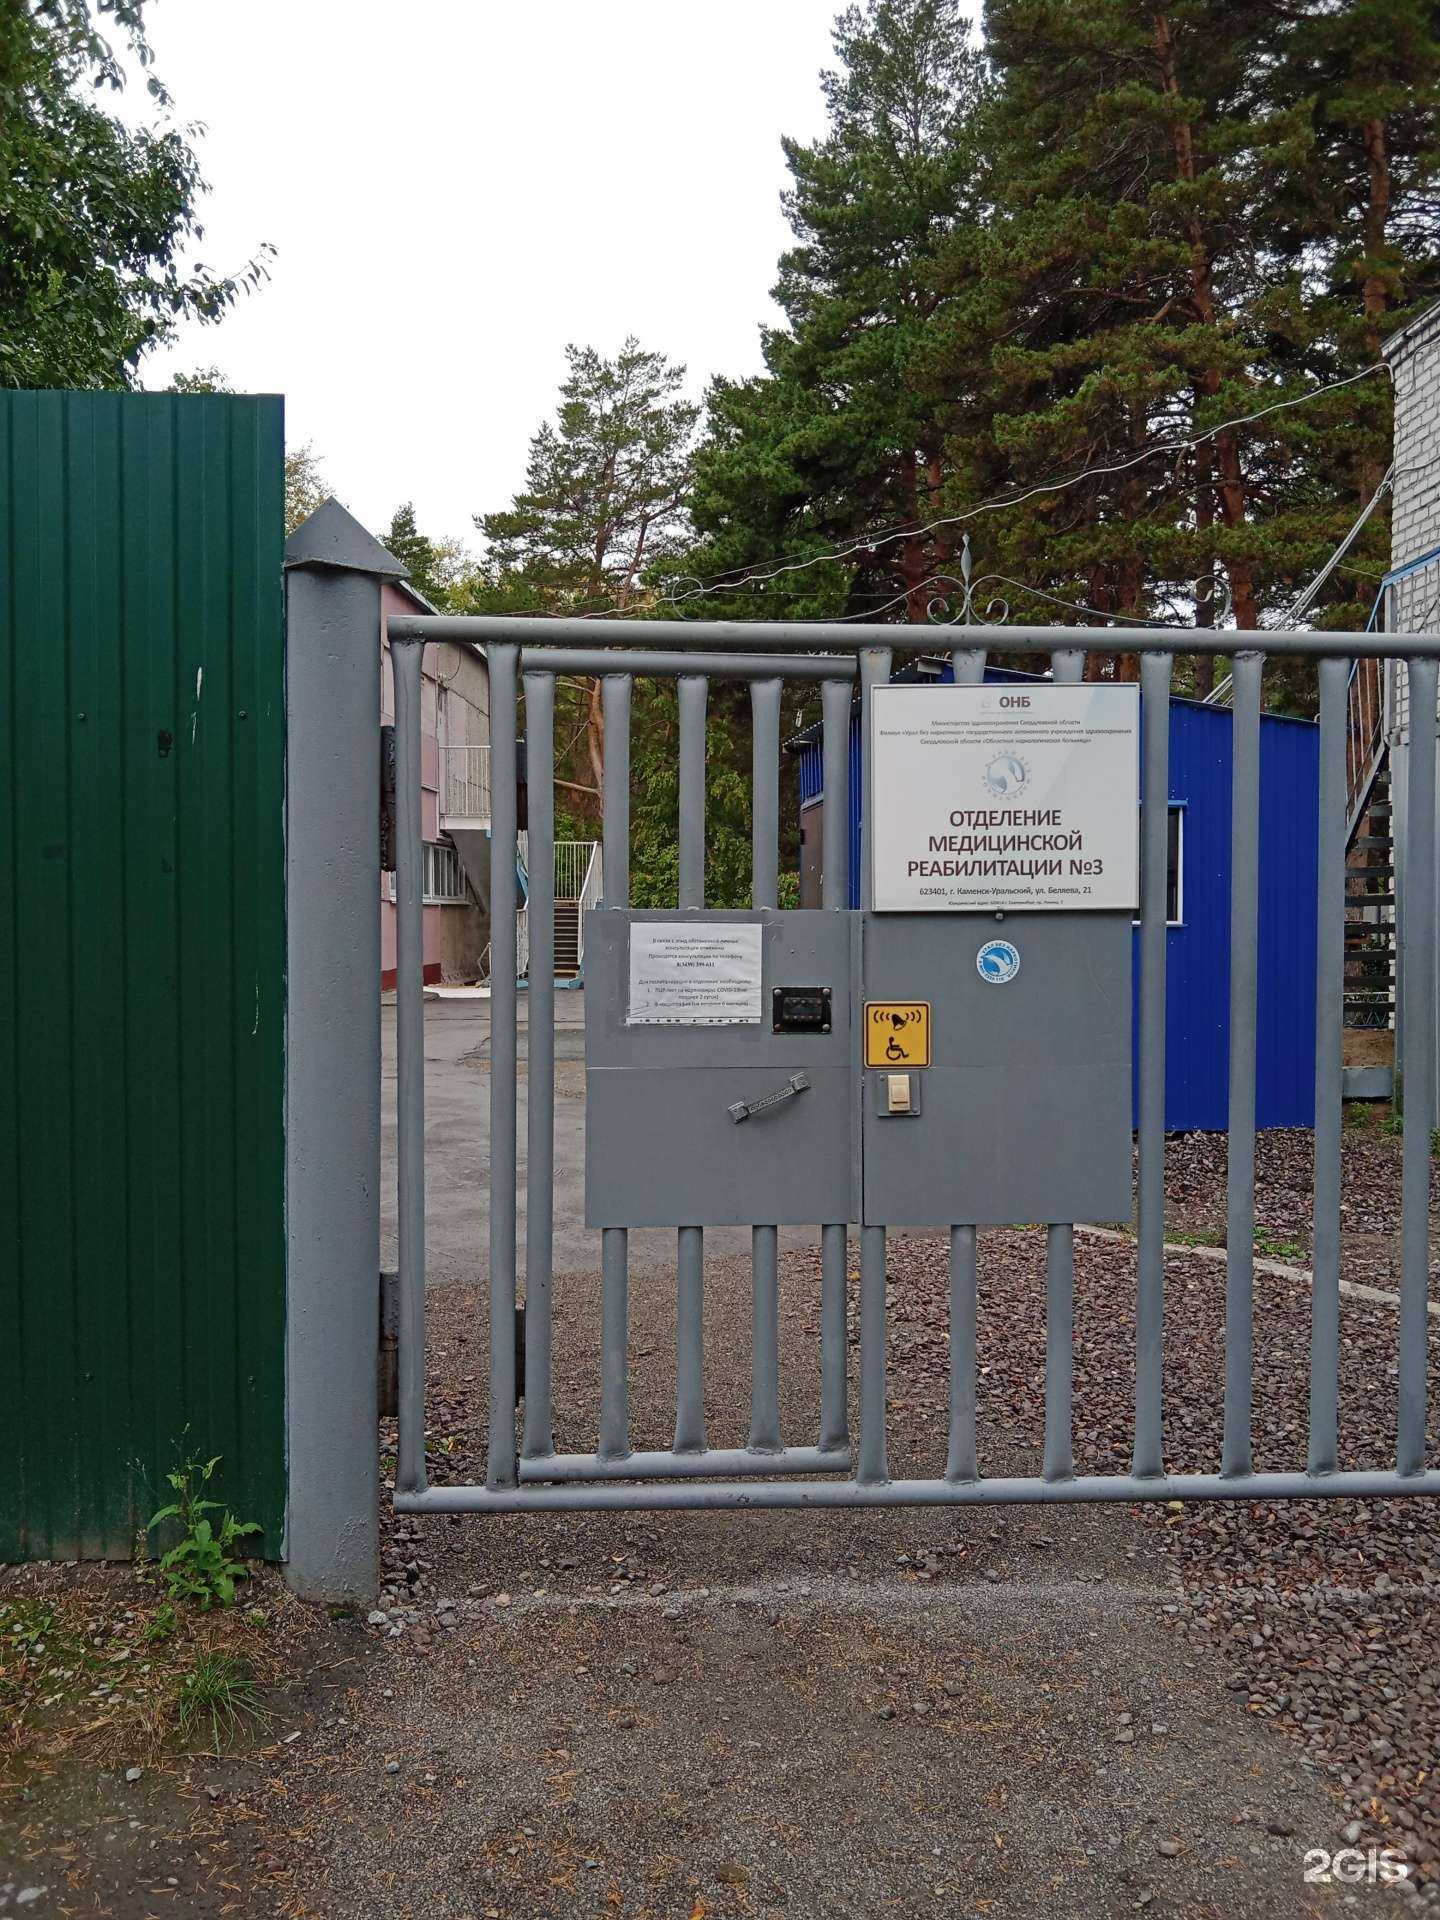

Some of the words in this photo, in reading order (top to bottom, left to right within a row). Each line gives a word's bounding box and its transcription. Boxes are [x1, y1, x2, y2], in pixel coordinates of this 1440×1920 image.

[999, 696, 1031, 708] ОНБ
[950, 809, 1062, 830] ОТДЕЛЕНИЕ
[929, 830, 1083, 855] МЕДИЦИНСКОЙ
[907, 859, 1062, 879] РЕАБИЛИТАЦИИ
[1069, 858, 1104, 876] №3
[919, 888, 948, 896] 623401,
[1035, 888, 1046, 896] ул.
[1082, 886, 1092, 894] 21
